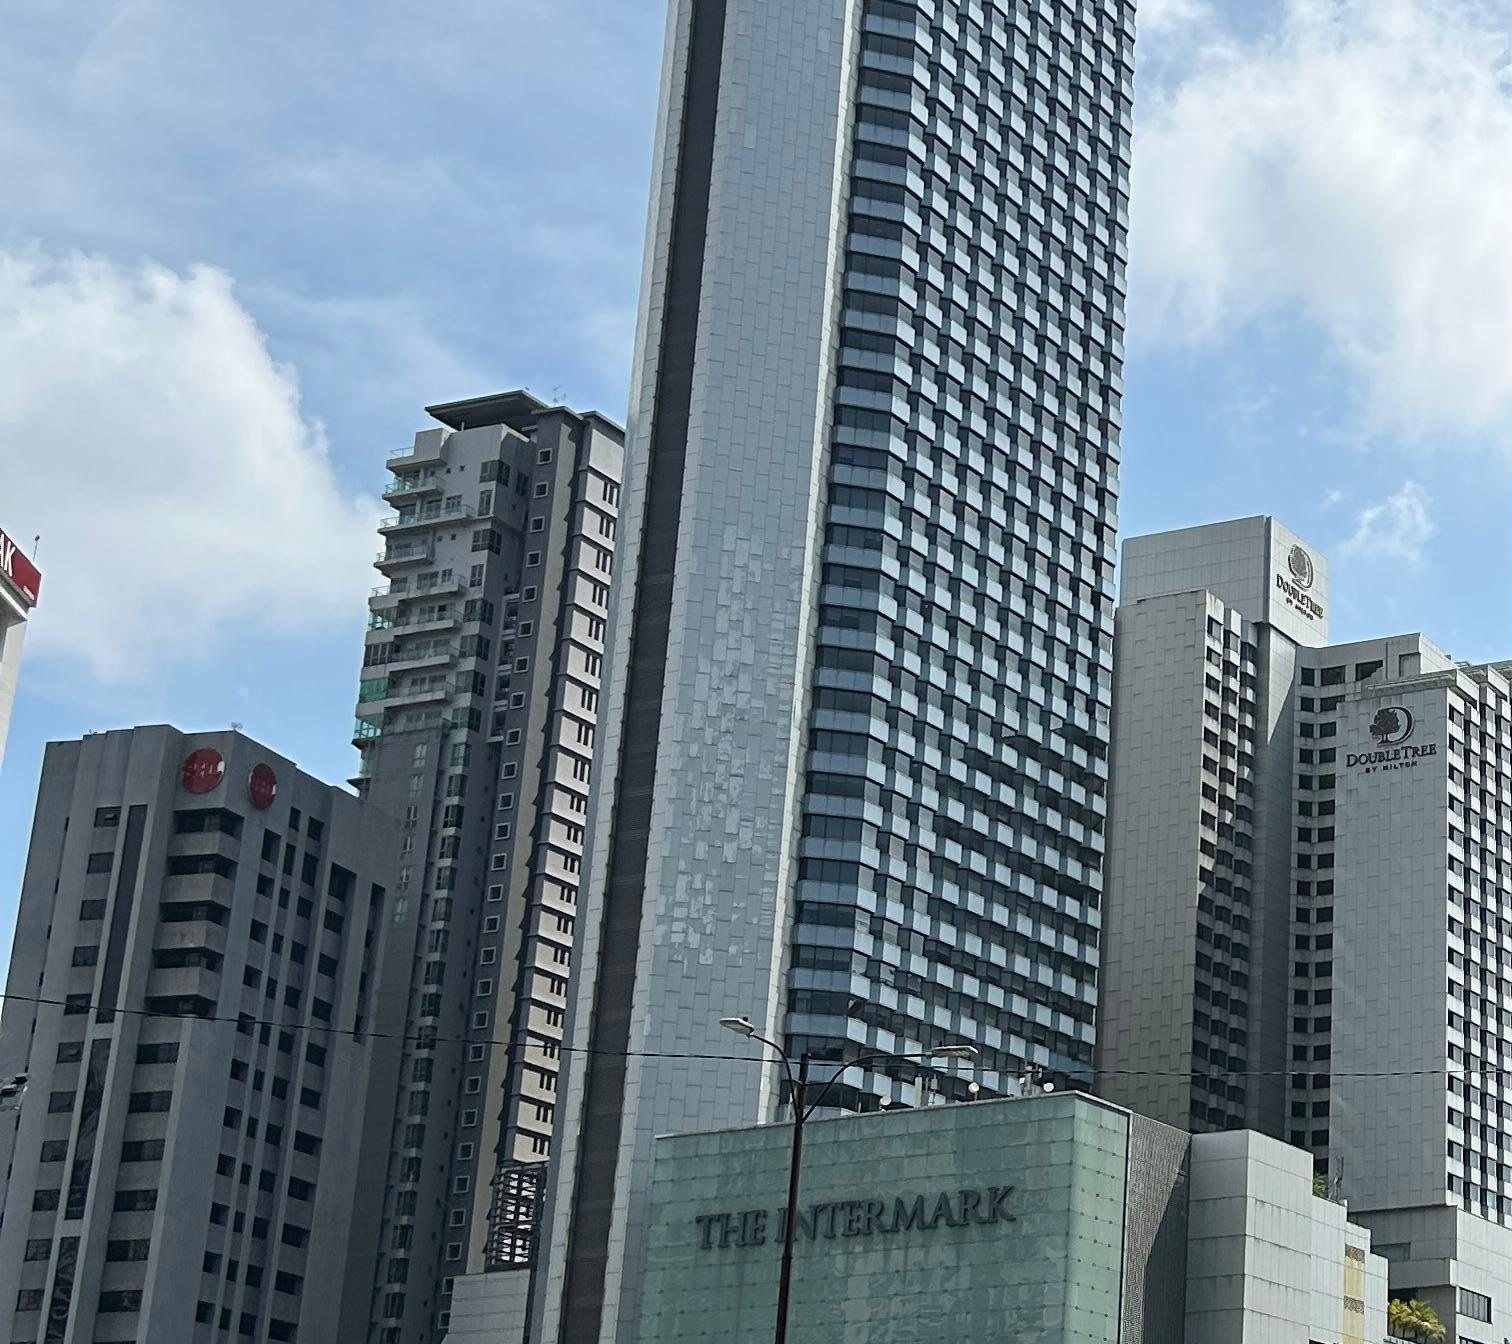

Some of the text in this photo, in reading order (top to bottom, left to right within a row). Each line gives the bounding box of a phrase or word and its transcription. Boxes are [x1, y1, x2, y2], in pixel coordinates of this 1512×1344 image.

[1365, 761, 1418, 774] BY HILTON
[695, 1185, 1017, 1250] THE INTERMARK
